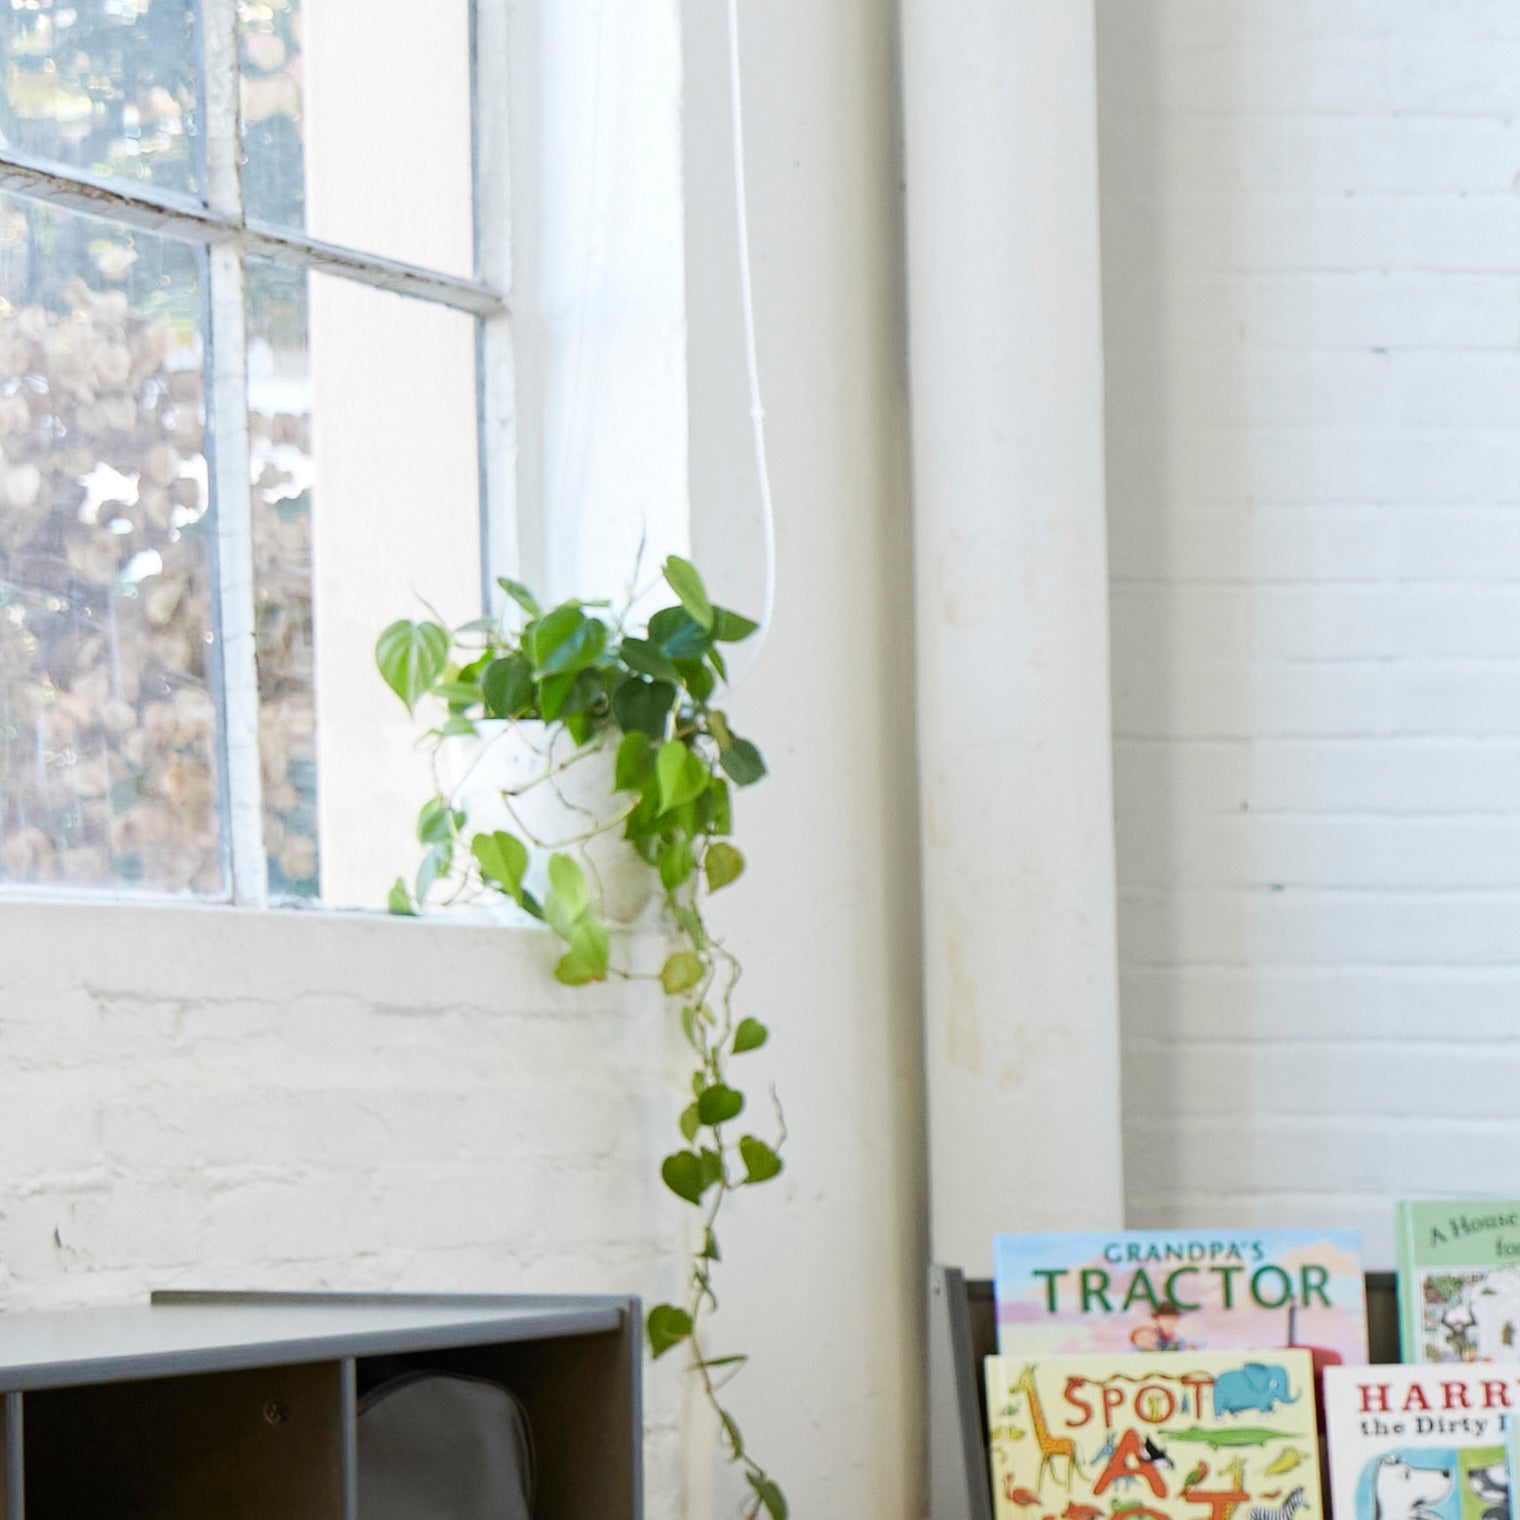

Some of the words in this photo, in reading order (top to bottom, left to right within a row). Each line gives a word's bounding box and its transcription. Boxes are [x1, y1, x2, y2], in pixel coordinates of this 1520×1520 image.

[1430, 1225, 1448, 1248] A
[1449, 1210, 1519, 1239] House
[1103, 1239, 1265, 1265] GRANDPA'S
[1032, 1264, 1332, 1315] TRACTOR
[1064, 1370, 1215, 1429] SPOT
[1361, 1417, 1405, 1436] the
[1415, 1413, 1488, 1437] Dirty
[1093, 1428, 1167, 1499] A
